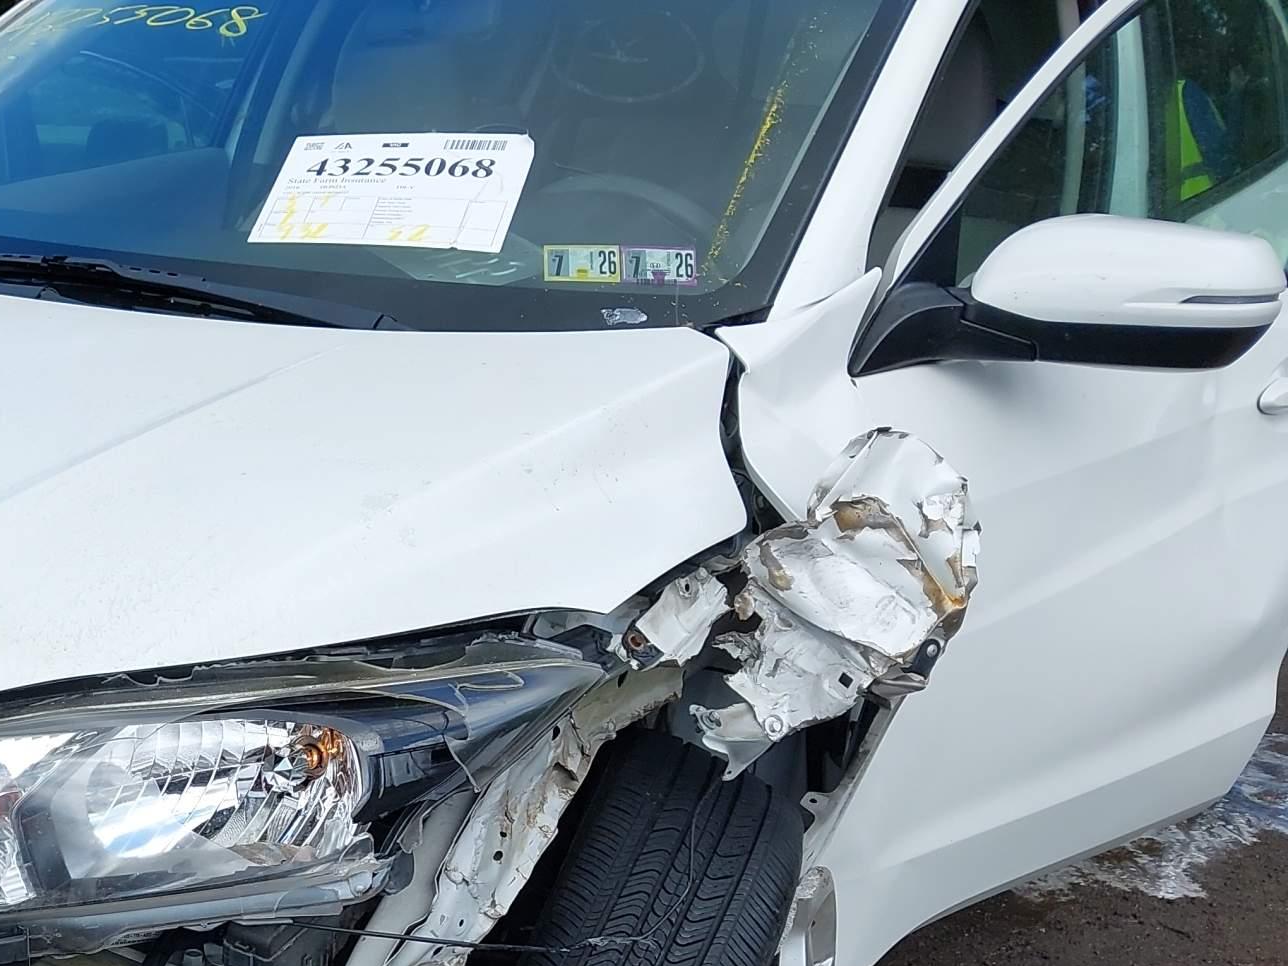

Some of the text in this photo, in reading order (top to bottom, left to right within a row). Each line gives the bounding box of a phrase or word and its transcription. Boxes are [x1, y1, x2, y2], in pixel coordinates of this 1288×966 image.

[306, 157, 497, 179] 43255068
[553, 254, 564, 277] 7
[598, 250, 617, 275] 26
[631, 255, 641, 278] 7
[674, 252, 694, 278] 26
